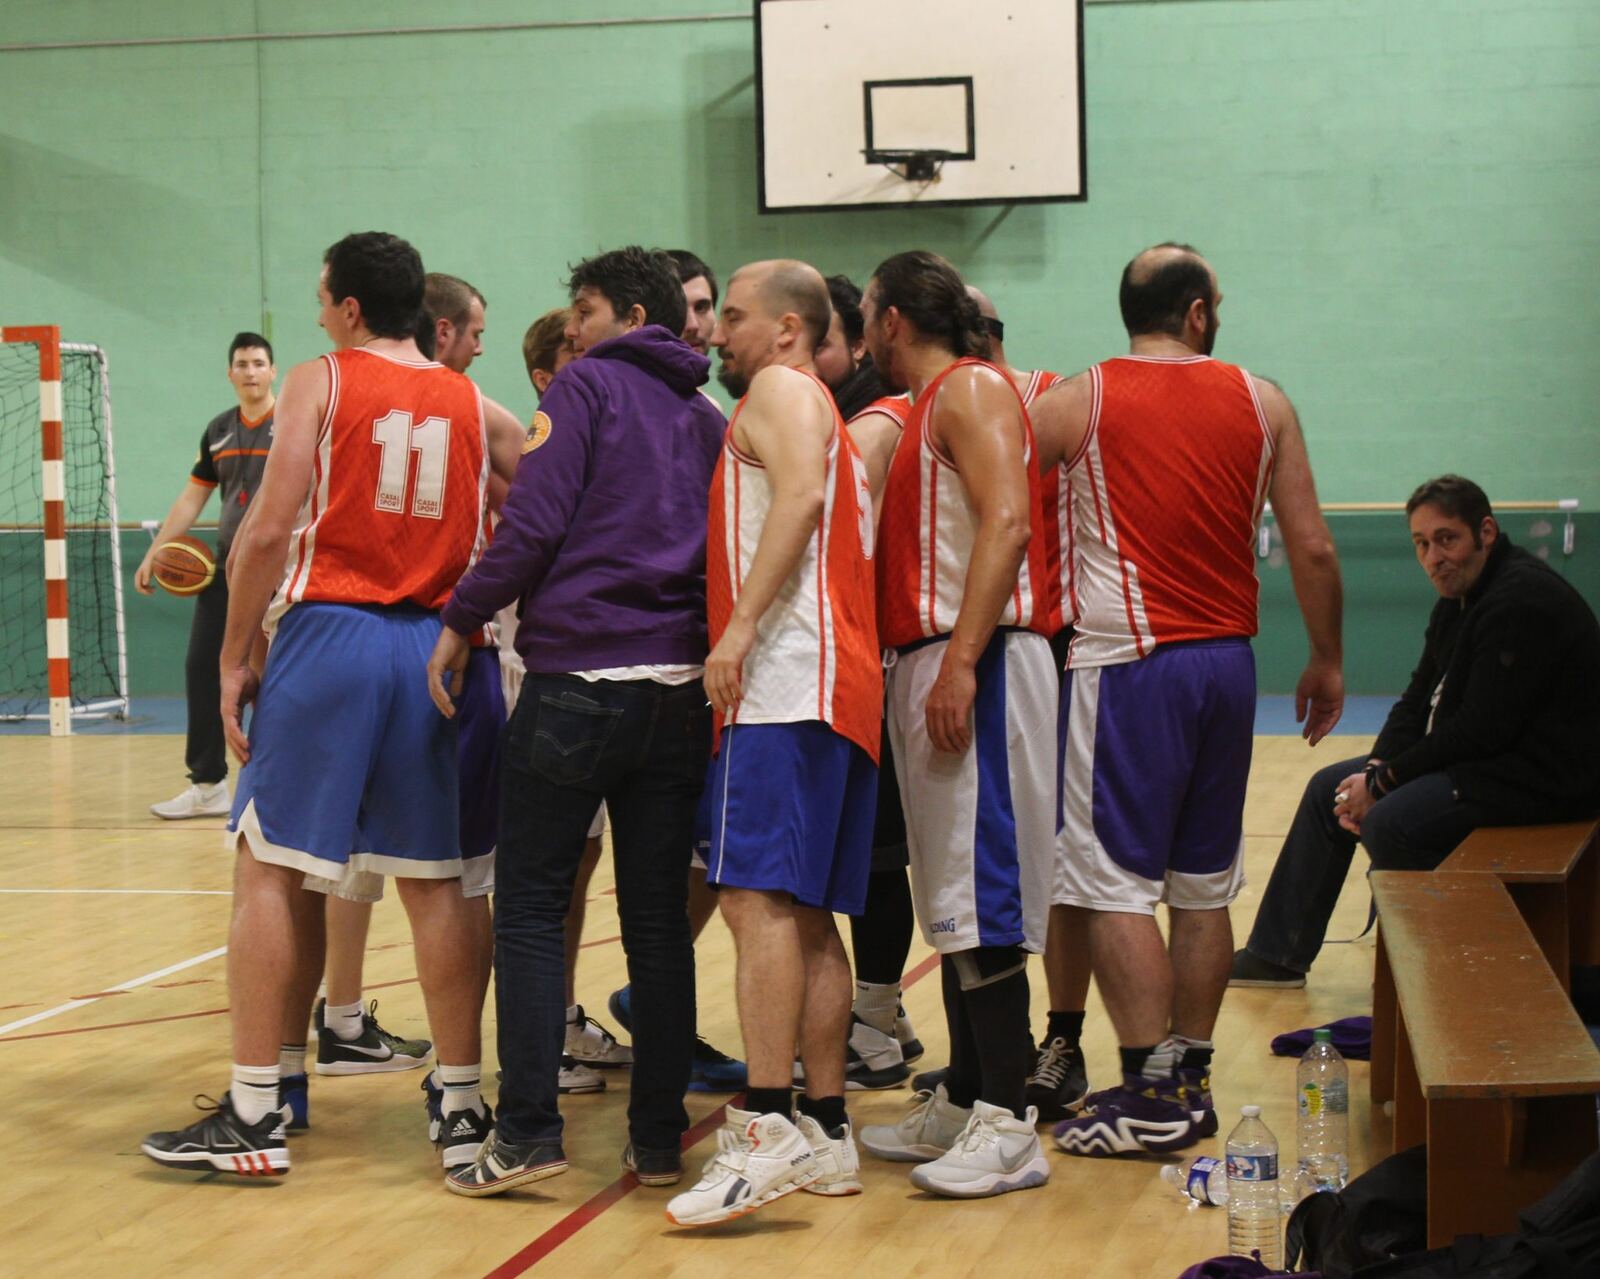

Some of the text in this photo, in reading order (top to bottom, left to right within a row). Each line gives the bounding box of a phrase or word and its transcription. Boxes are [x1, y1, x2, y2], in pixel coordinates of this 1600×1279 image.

[372, 409, 450, 519] 11
[380, 493, 400, 501] CASAL
[379, 499, 400, 507] SPORT
[416, 498, 438, 507] CASAL
[416, 505, 438, 513] SPORT
[451, 1129, 477, 1137] adidas
